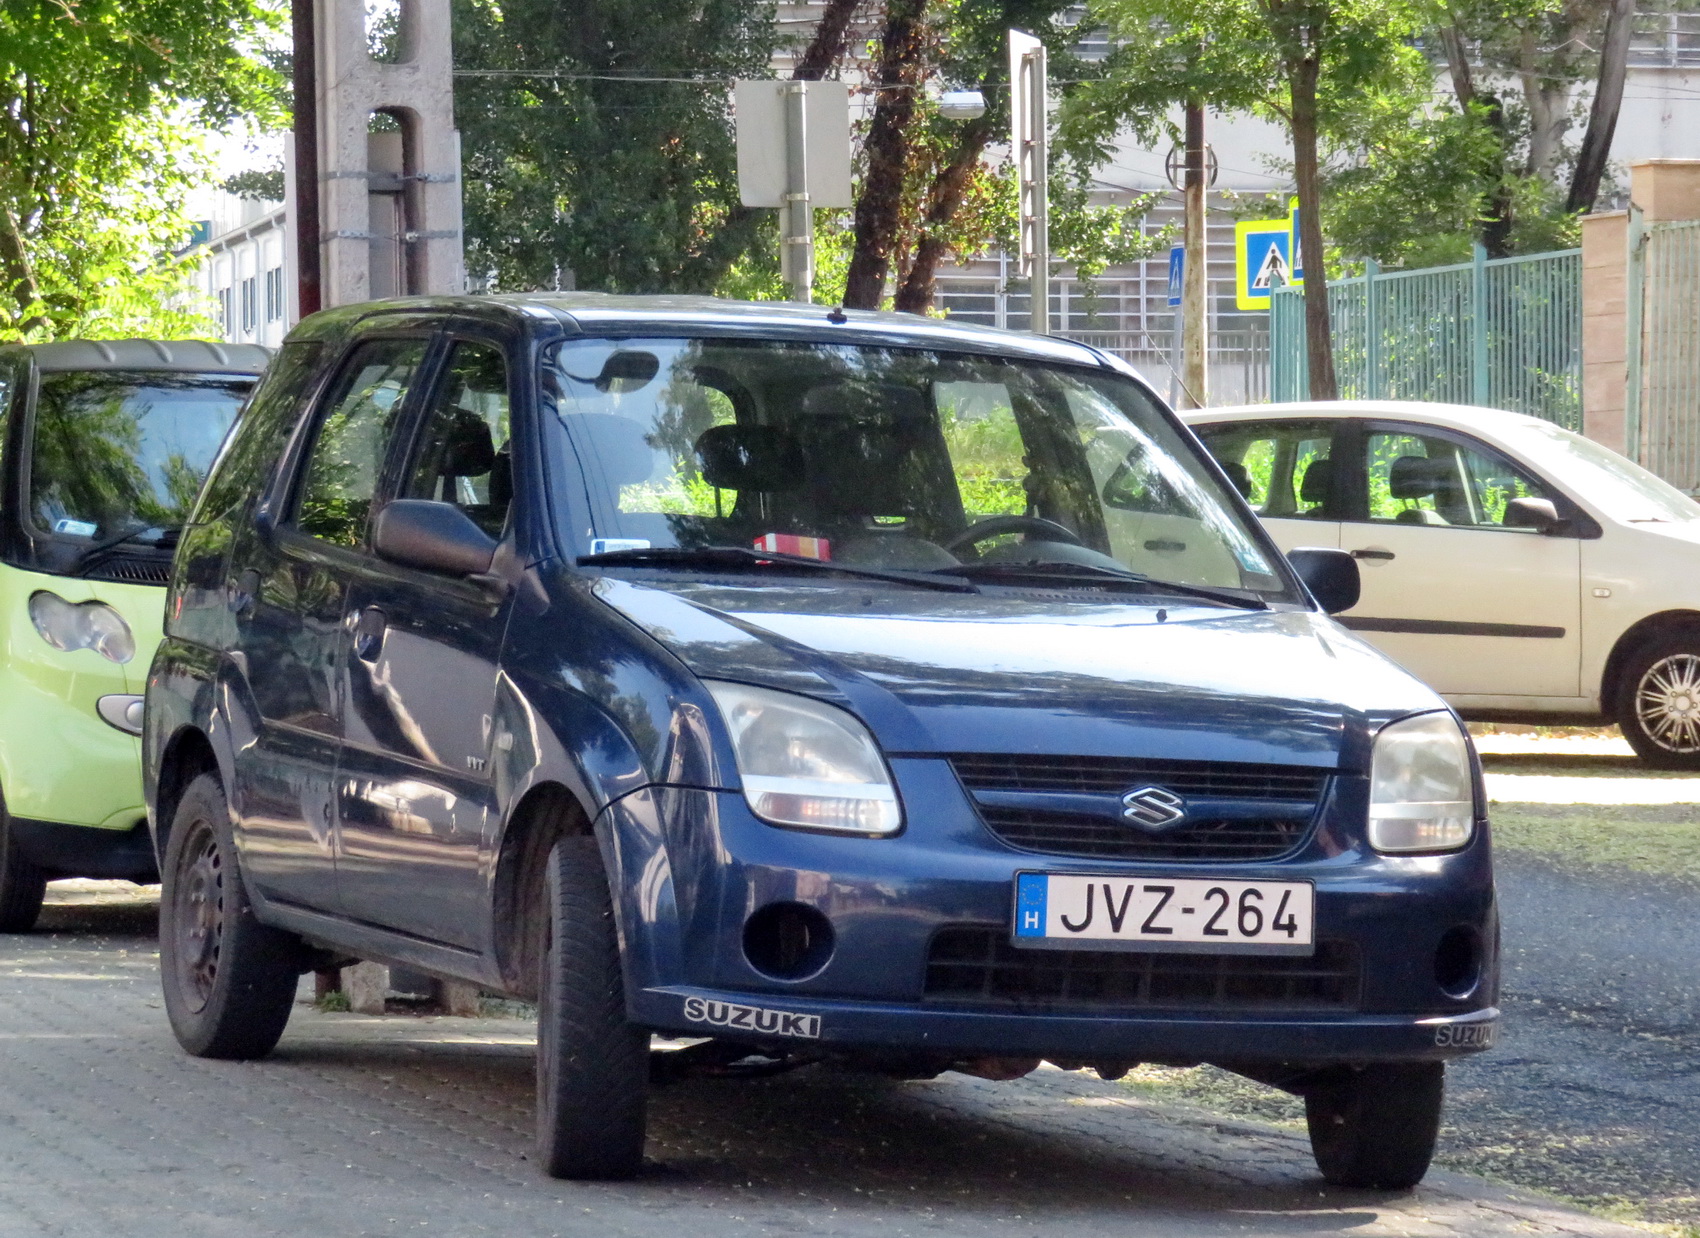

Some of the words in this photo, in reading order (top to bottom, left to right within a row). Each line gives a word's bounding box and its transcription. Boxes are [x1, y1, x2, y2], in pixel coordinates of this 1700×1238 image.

[1025, 911, 1039, 929] H
[1060, 883, 1298, 939] JVZ-264
[684, 997, 821, 1039] SUZUKI
